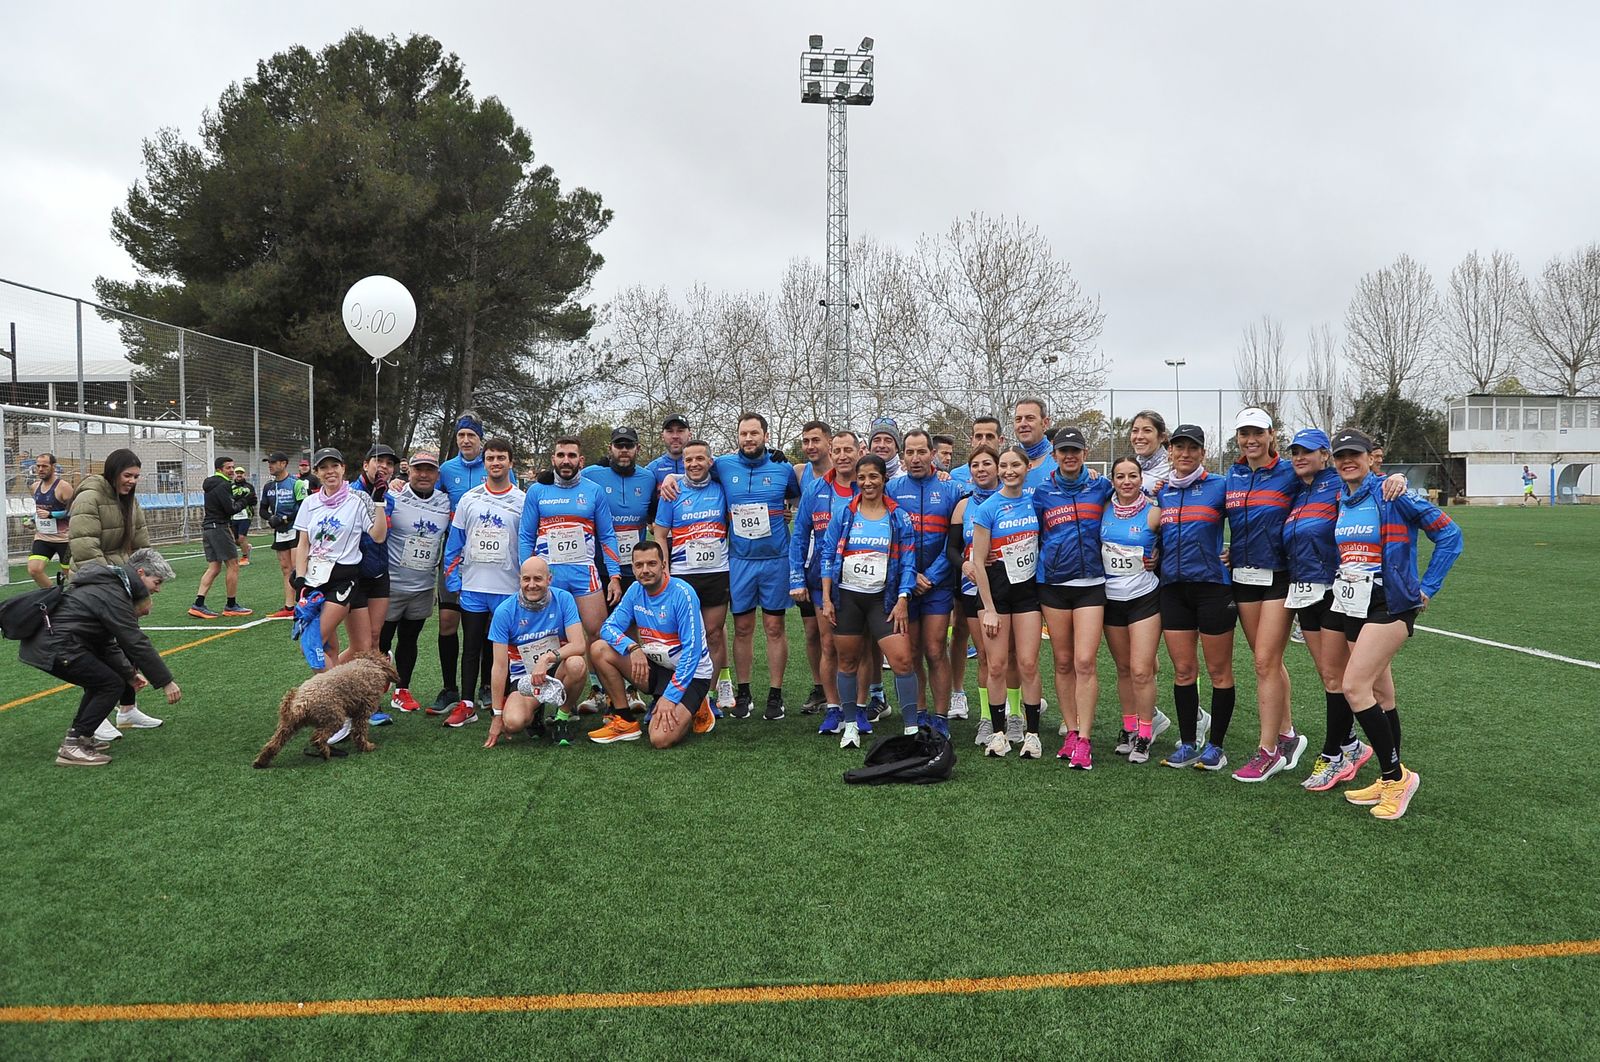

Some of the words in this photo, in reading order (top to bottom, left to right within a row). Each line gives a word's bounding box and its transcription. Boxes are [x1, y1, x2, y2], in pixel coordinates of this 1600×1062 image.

[611, 514, 641, 524] nerplus
[681, 509, 721, 521] enerplus
[740, 516, 761, 529] 884
[998, 515, 1039, 529] enerplu
[1335, 523, 1375, 538] nerplus
[479, 540, 500, 551] 960
[556, 539, 579, 552] 676
[848, 535, 890, 547] enerplu
[412, 548, 431, 560] 158
[695, 550, 715, 562] 209
[1016, 551, 1035, 568] 660
[853, 562, 875, 576] 641
[1110, 557, 1133, 569] 815
[1341, 585, 1355, 599] 80
